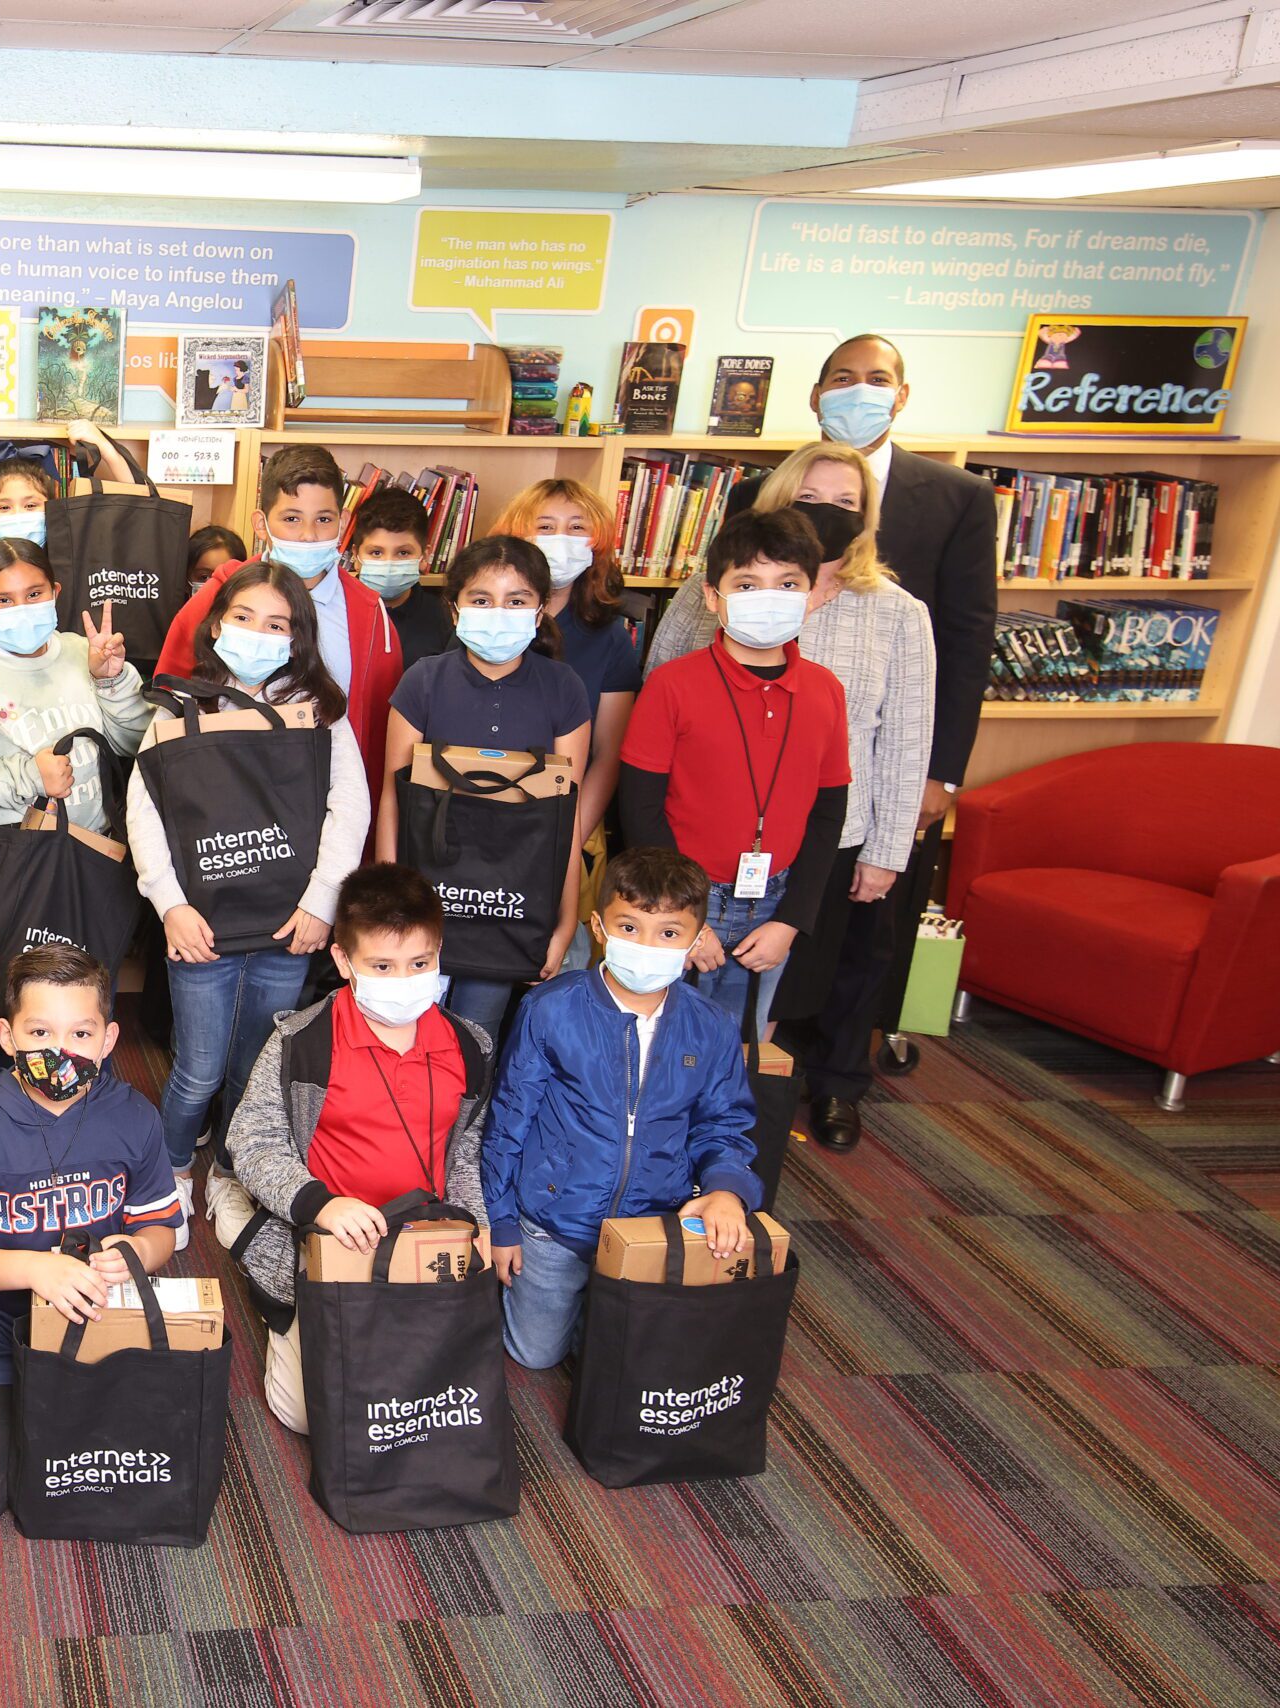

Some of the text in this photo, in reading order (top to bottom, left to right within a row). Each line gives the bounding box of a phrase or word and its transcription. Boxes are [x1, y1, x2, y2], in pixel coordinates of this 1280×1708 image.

[37, 235, 80, 253] than
[86, 237, 132, 255] what
[138, 239, 153, 255] is
[159, 240, 188, 257] set
[193, 241, 244, 259] down
[250, 245, 273, 260] on
[441, 237, 586, 252] “The man who has no
[792, 222, 1211, 256] “Hold fast to dreams, For if dreams die,
[17, 259, 82, 278] human
[88, 264, 139, 281] voice
[144, 265, 163, 282] to
[169, 266, 225, 284] infuse
[232, 268, 278, 286] them
[420, 255, 500, 271] imagination
[504, 257, 528, 270] has
[531, 259, 548, 270] no
[760, 252, 801, 272] Life
[806, 253, 825, 273] is
[830, 258, 843, 273] a
[850, 255, 926, 275] broken
[931, 258, 1010, 282] winged
[1014, 259, 1058, 278] bird
[1062, 260, 1104, 280] that
[1109, 261, 1184, 282] cannot
[464, 275, 565, 289] Muhammad Ali
[111, 289, 160, 310] Maya
[165, 291, 243, 312] Angelou
[905, 286, 1093, 313] Langston Hughes
[720, 358, 772, 370] MORE BONES
[632, 389, 667, 401] Bones
[1017, 371, 1232, 416] Reference
[162, 452, 179, 460] 000
[89, 584, 159, 599] essentials
[1120, 615, 1218, 647] BOOK
[196, 822, 284, 853] internet
[202, 866, 261, 882] FROM COMCAST
[457, 1255, 466, 1280] 3481
[368, 1384, 457, 1421] internet
[641, 1375, 730, 1407] internet
[639, 1389, 741, 1425] essentials
[368, 1403, 483, 1441] essentials
[639, 1421, 701, 1436] FROM COMCAST
[369, 1433, 429, 1454] FROM COMCAST
[45, 1449, 147, 1473] internet
[45, 1465, 171, 1489] essentials
[45, 1485, 114, 1498] FROM COMCAST
